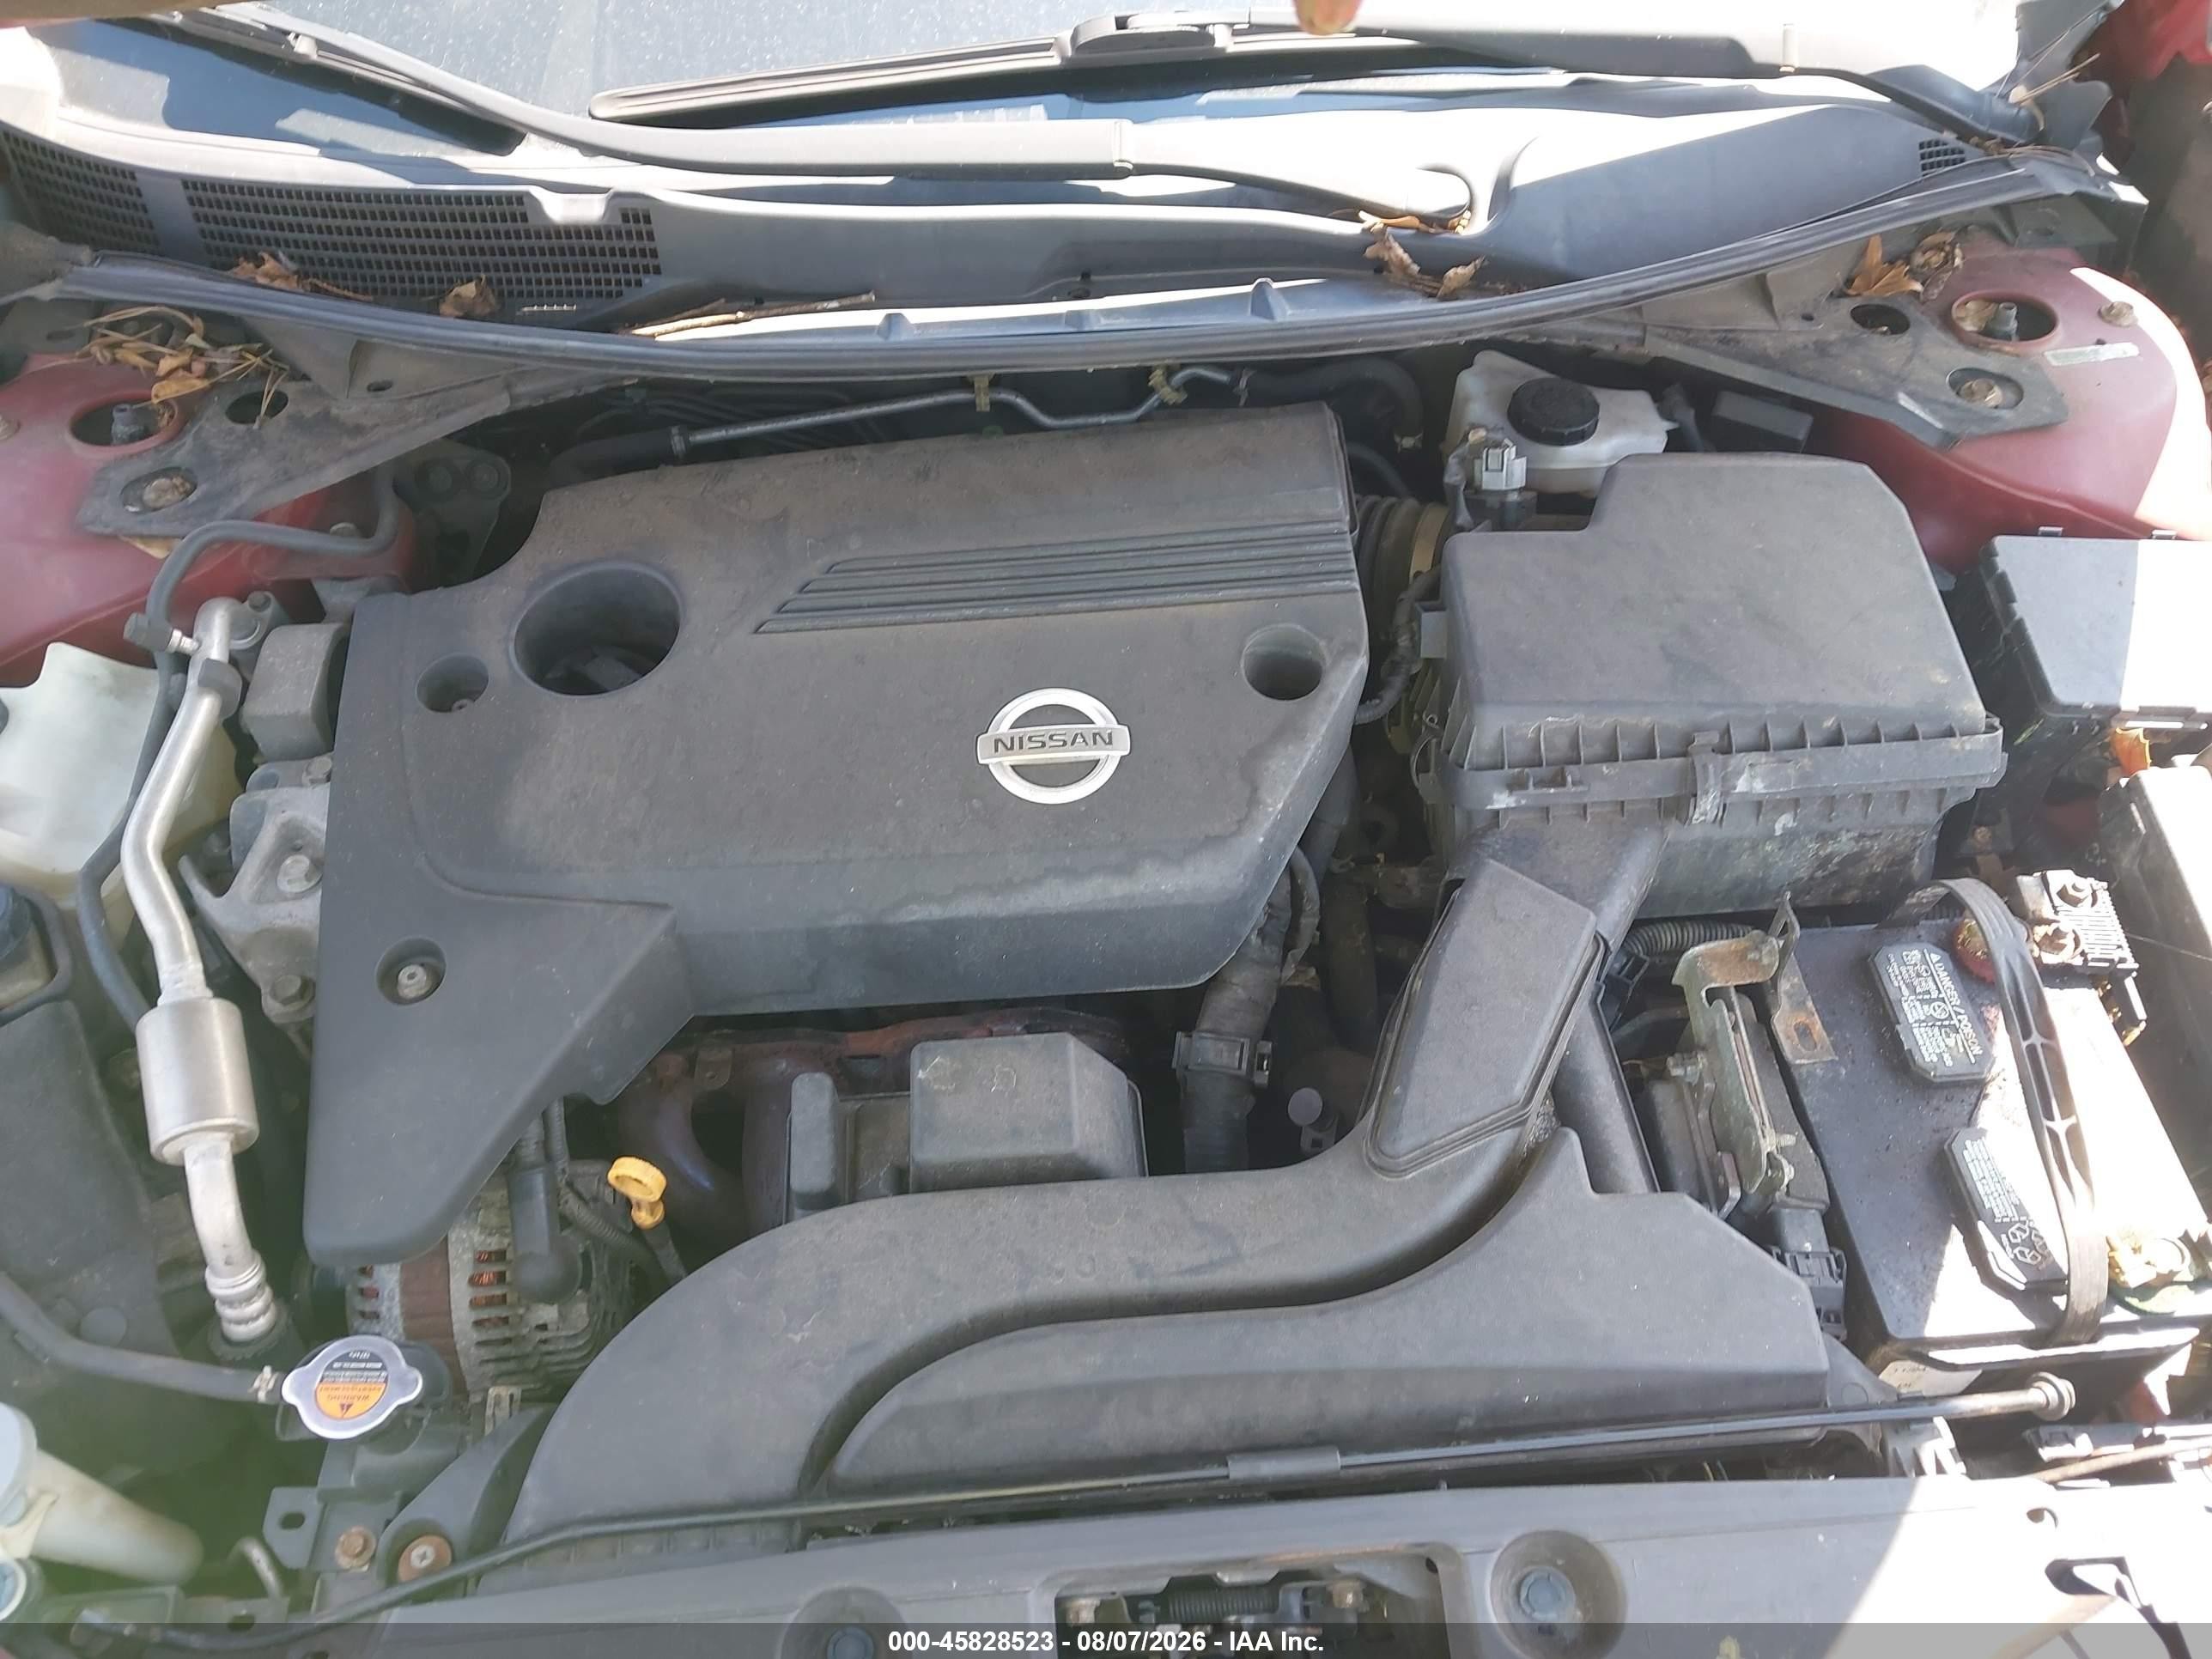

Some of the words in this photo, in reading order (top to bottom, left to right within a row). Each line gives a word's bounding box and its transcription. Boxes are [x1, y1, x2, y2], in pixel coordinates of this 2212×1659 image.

[994, 731, 1113, 753] NISSAN
[1934, 963, 1960, 1006] DANGER
[1957, 1014, 1984, 1055] POISON
